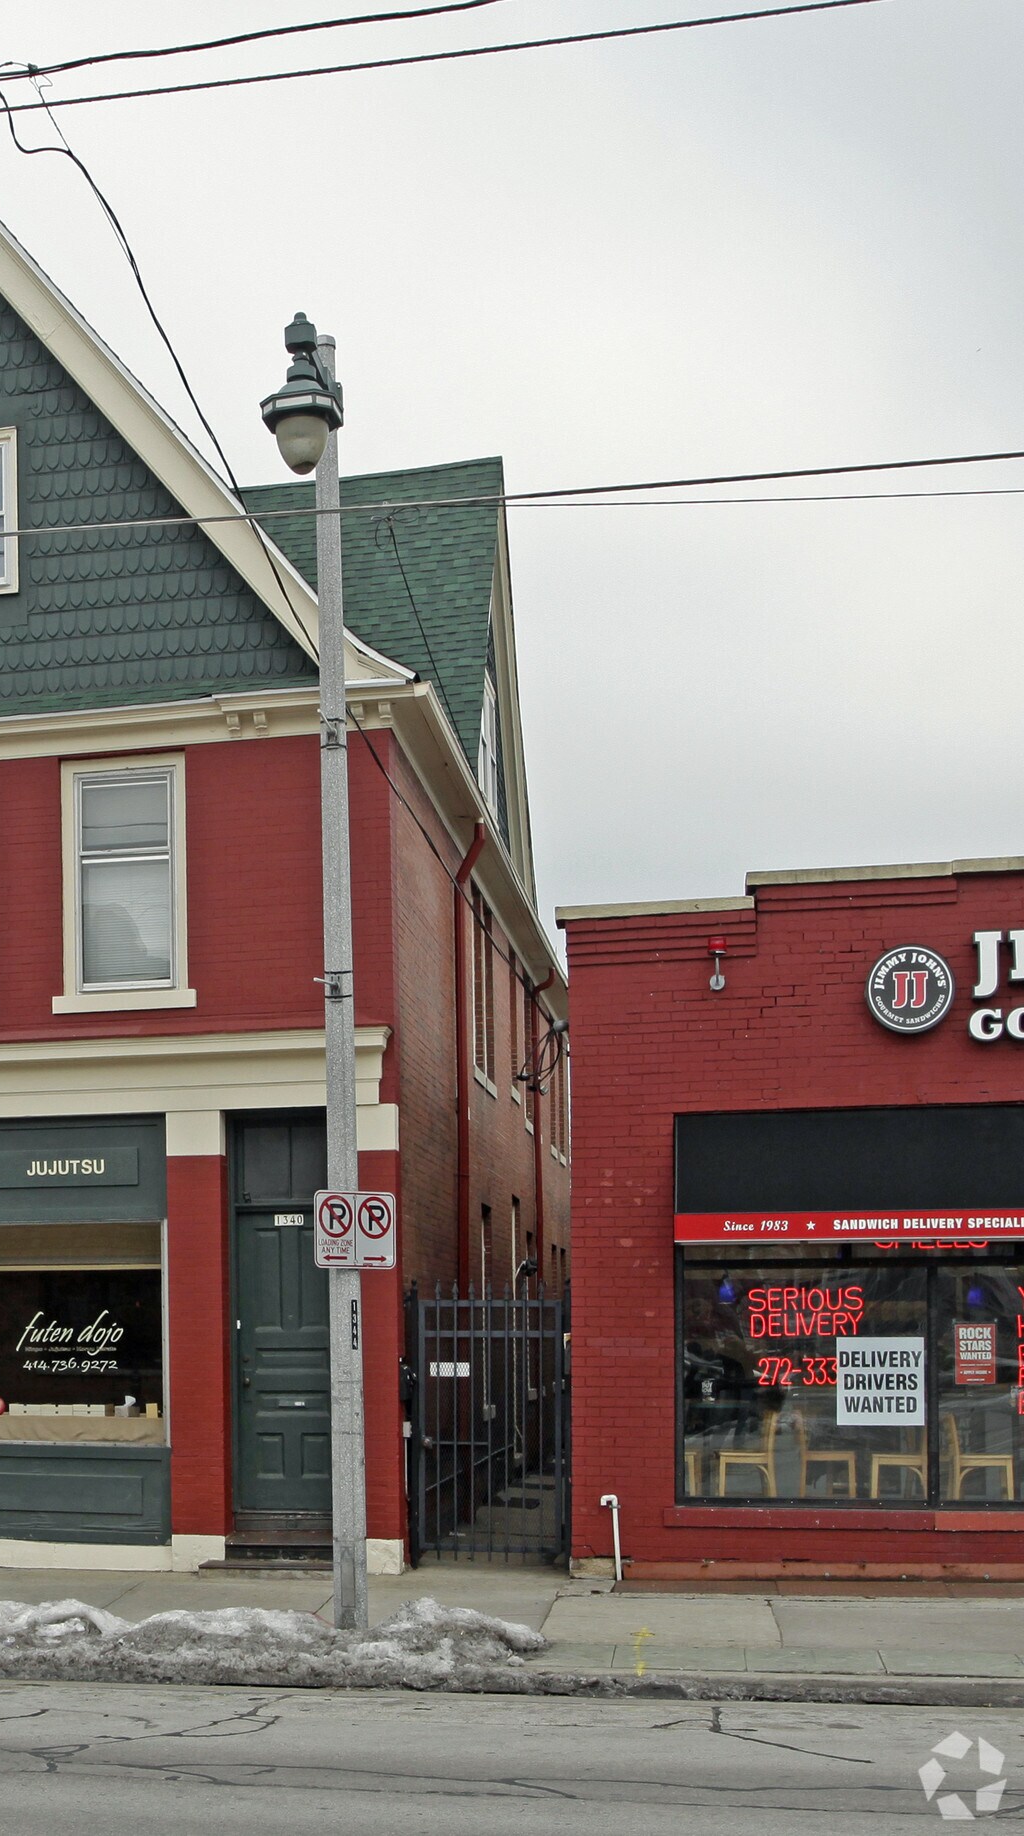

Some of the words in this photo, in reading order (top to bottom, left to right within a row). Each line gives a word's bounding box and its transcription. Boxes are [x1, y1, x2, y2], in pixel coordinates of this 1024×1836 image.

[874, 952, 907, 990] JIMMY
[911, 952, 946, 989] JOHN'S
[892, 971, 928, 1008] JJ
[875, 996, 904, 1024] GOURMET
[905, 994, 945, 1024] SANDWICHES
[26, 1159, 105, 1176] JUJUTSU
[277, 1214, 303, 1225] 1340
[723, 1220, 754, 1231] Since
[760, 1220, 789, 1231] 1983
[833, 1218, 899, 1230] SANDWICH
[903, 1217, 963, 1229] DELIVERY
[318, 1238, 340, 1247] LOADING
[341, 1239, 353, 1247] ZONE
[321, 1246, 335, 1254] ANY
[336, 1247, 351, 1255] TIME
[748, 1286, 864, 1312] SERIOUS
[750, 1311, 863, 1338] DELIVERY
[16, 1311, 74, 1351] futen
[77, 1310, 124, 1356] dojo
[959, 1328, 992, 1339] ROCK
[959, 1341, 992, 1351] STARS
[839, 1351, 922, 1367] DELIVERY
[959, 1352, 992, 1360] WANTED
[23, 1357, 118, 1372] 414.736.9272
[843, 1373, 918, 1390] DRIVERS
[844, 1396, 918, 1413] WANTED
